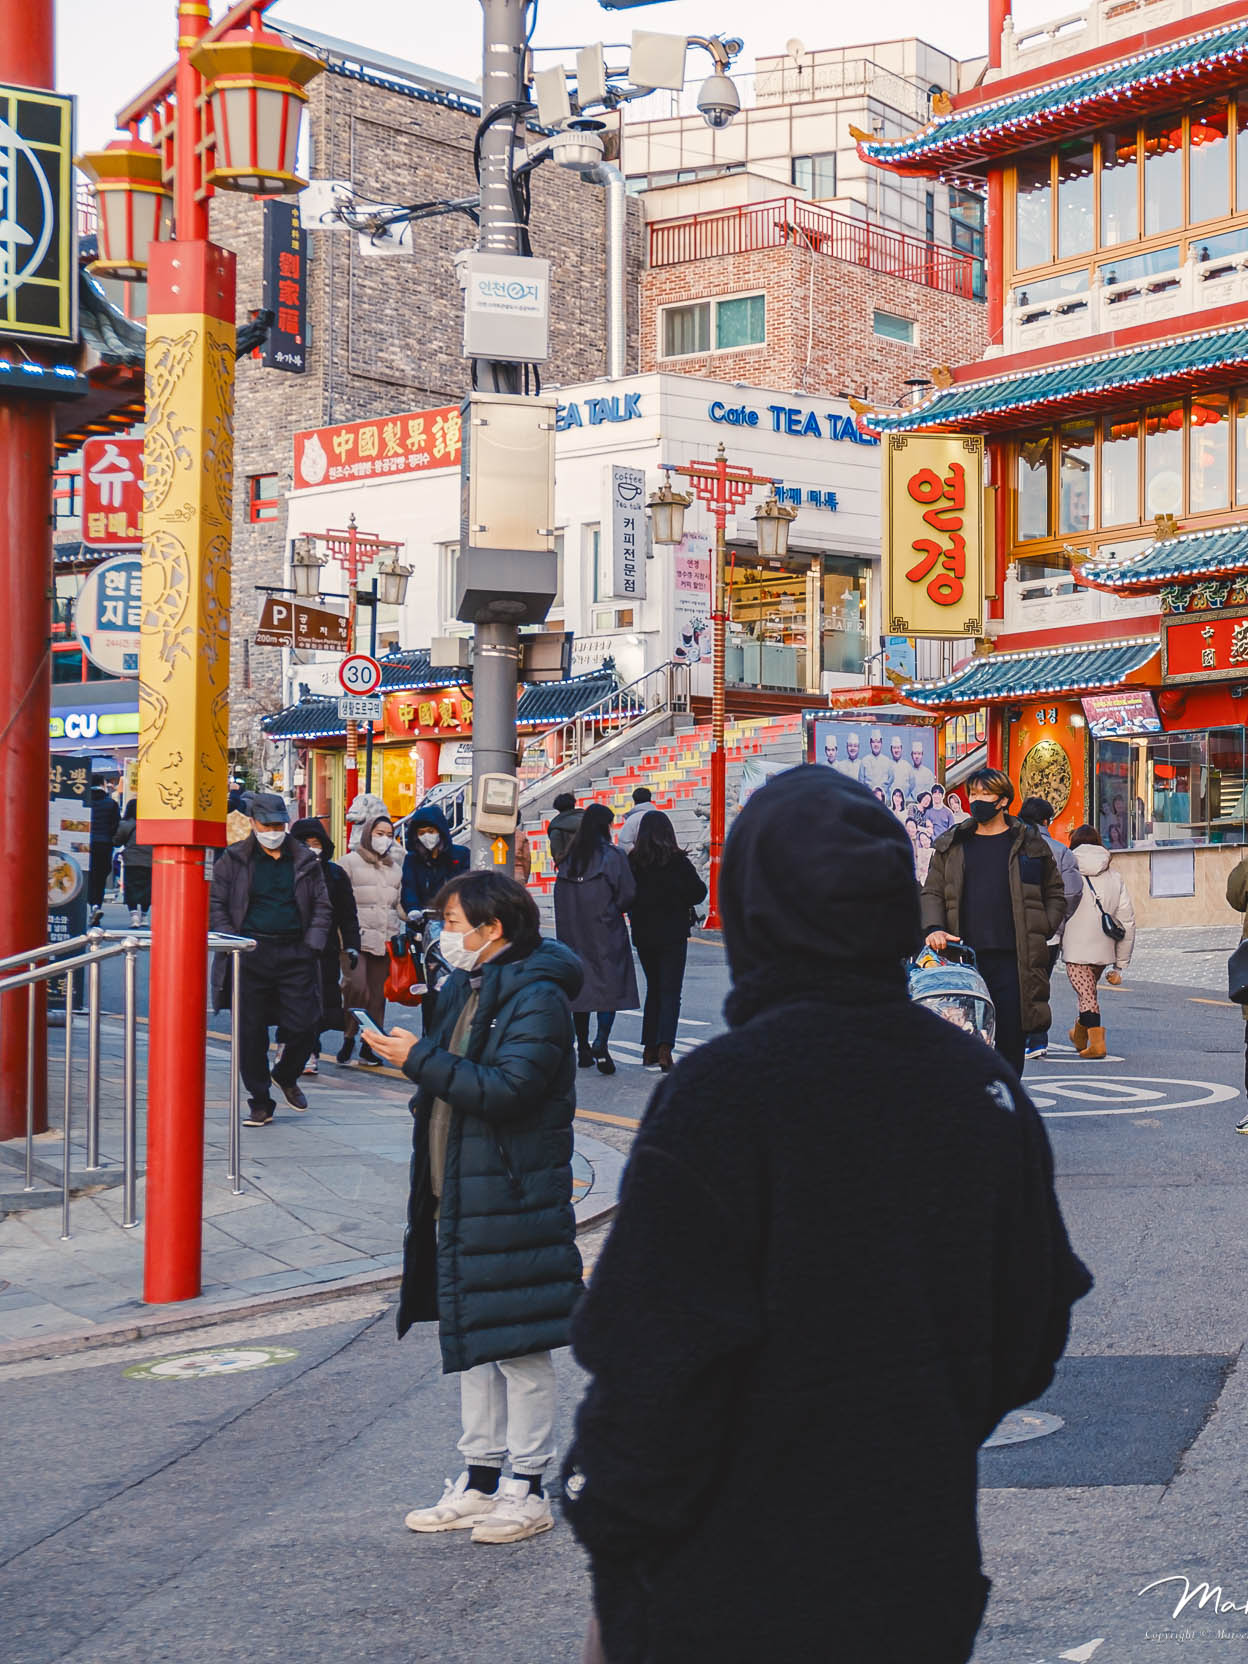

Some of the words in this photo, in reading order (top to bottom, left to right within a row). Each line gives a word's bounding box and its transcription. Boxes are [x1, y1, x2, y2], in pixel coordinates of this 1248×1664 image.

[584, 392, 642, 425] TALK
[709, 401, 759, 427] Cafe
[768, 405, 822, 438] TEA
[88, 443, 144, 508] 슈
[906, 462, 966, 606] 연경
[623, 517, 636, 593] 커피전문점
[272, 605, 288, 626] P
[347, 666, 372, 684] 30
[64, 713, 98, 739] CU
[1035, 707, 1058, 726] 연경
